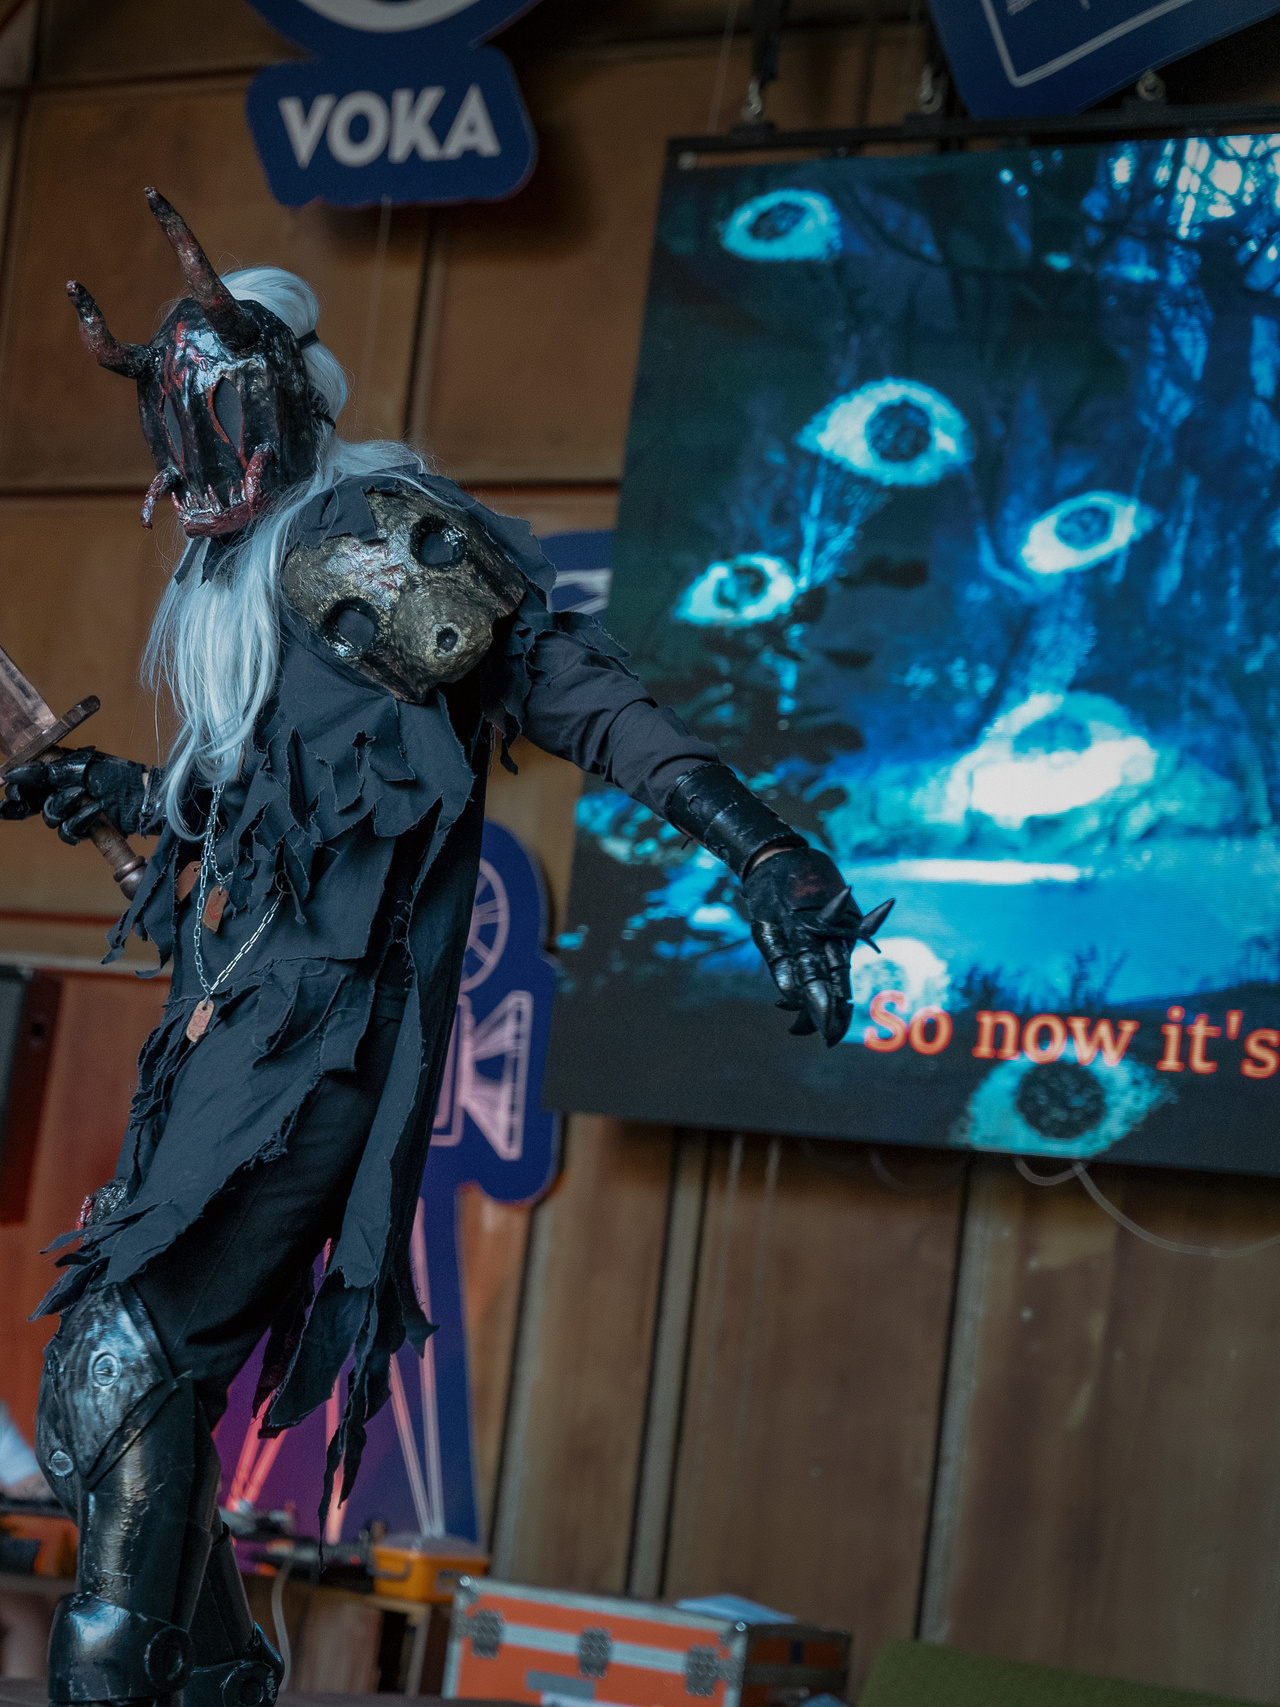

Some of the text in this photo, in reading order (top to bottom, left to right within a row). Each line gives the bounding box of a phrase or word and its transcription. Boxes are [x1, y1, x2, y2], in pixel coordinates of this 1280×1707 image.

[277, 83, 502, 170] VOKA
[863, 989, 1280, 1080] So now it's
